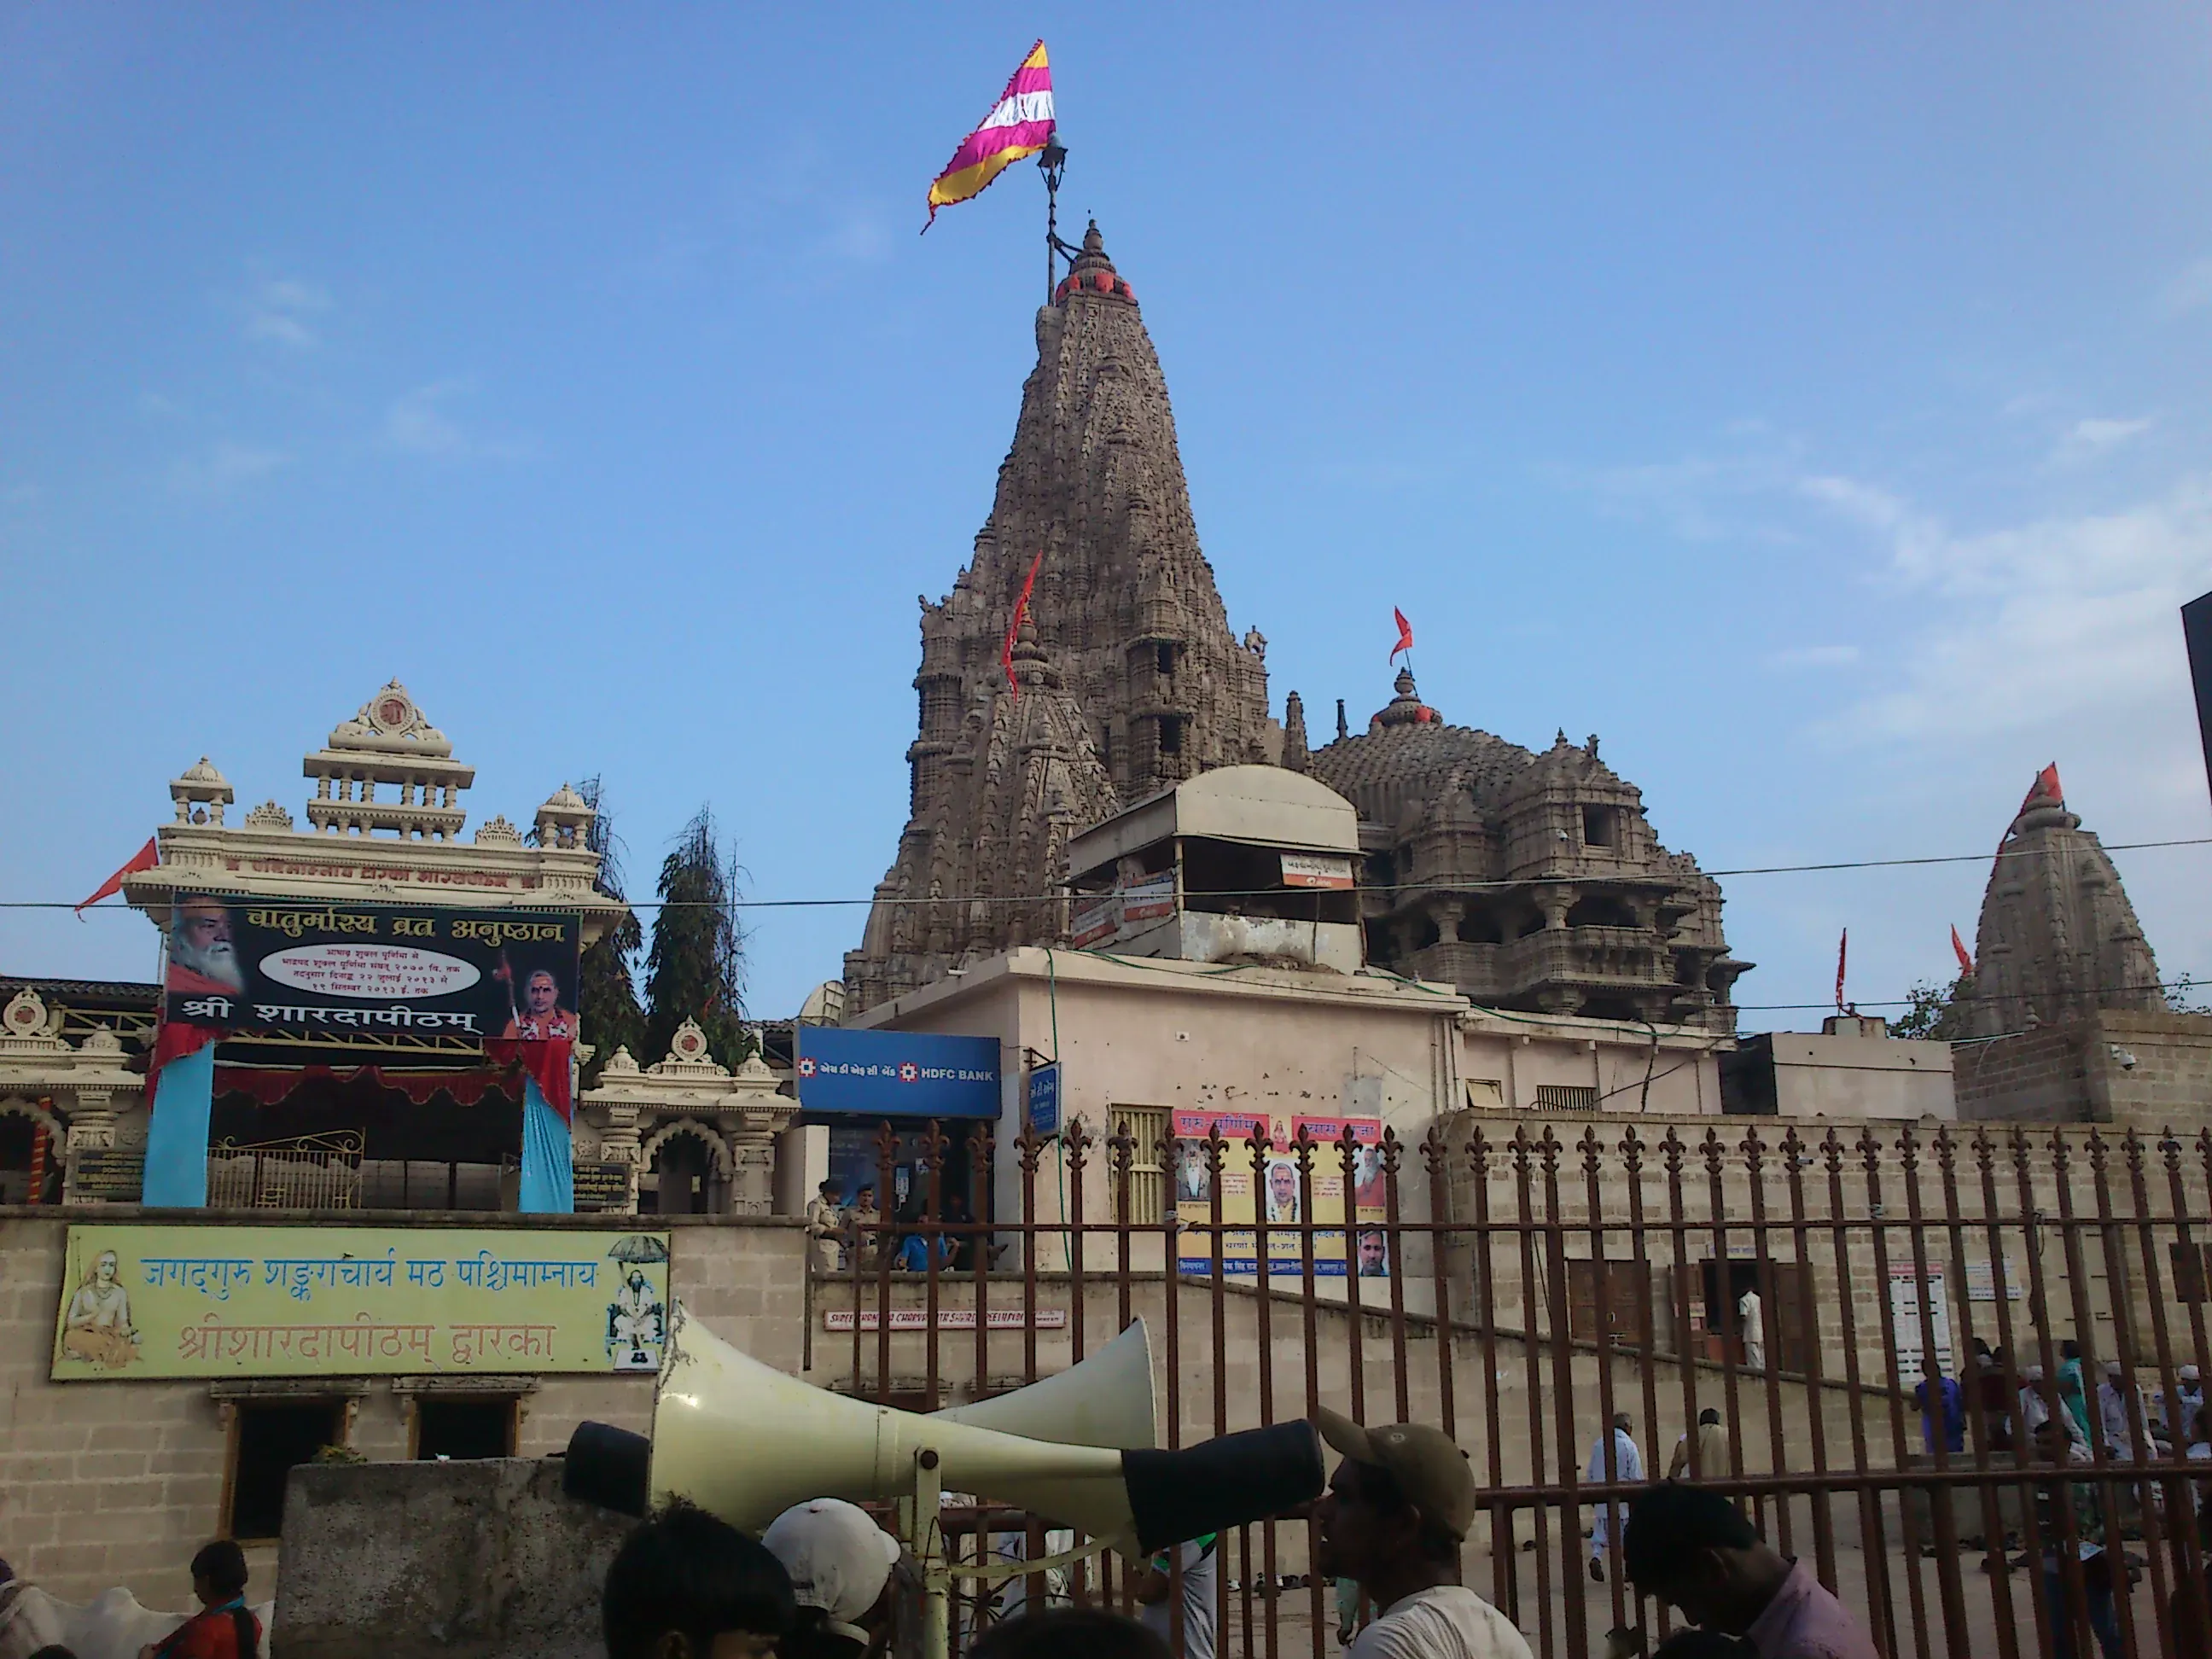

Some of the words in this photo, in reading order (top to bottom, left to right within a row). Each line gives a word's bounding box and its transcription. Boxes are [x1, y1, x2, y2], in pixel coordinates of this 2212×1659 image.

[247, 907, 378, 937] चातुर्मास्य
[392, 917, 436, 937] व्रत
[451, 919, 565, 947] अनुष्ठान
[181, 997, 234, 1018] श्री
[253, 1004, 484, 1035] शारदापीठम्
[921, 1068, 955, 1079] HDFC
[958, 1069, 993, 1081] BANK
[140, 1259, 253, 1300] जगद्गुरु
[406, 1260, 446, 1288] मठ
[456, 1249, 598, 1291] पश्चिमाम्नाय
[178, 1312, 443, 1371] श्रीशारदापीठम्
[450, 1325, 556, 1364] द्वारका
